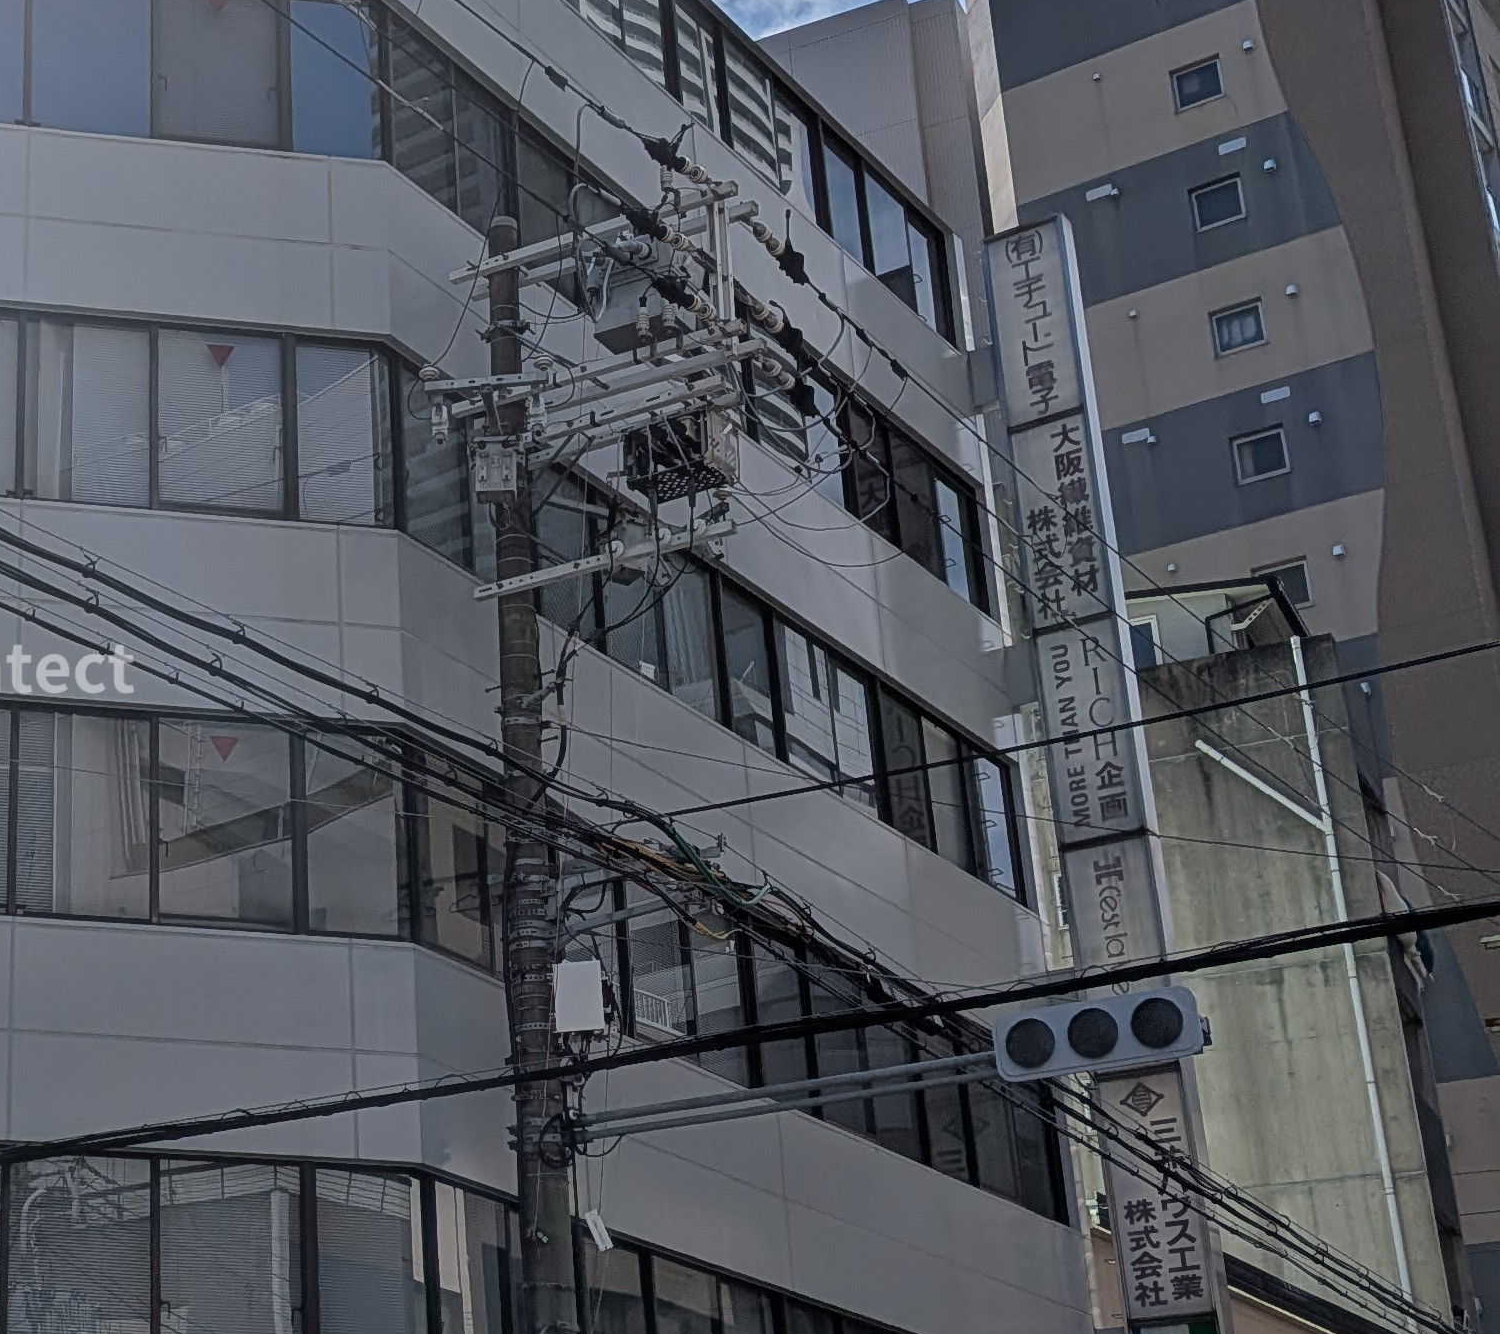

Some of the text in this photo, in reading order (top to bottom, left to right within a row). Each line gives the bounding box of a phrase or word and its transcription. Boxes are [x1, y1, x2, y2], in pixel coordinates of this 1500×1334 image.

[1027, 505, 1077, 621] 株式会社
[1050, 643, 1073, 690] YOU
[1067, 764, 1092, 828] MORE
[1123, 1198, 1169, 1307] 株式会社
